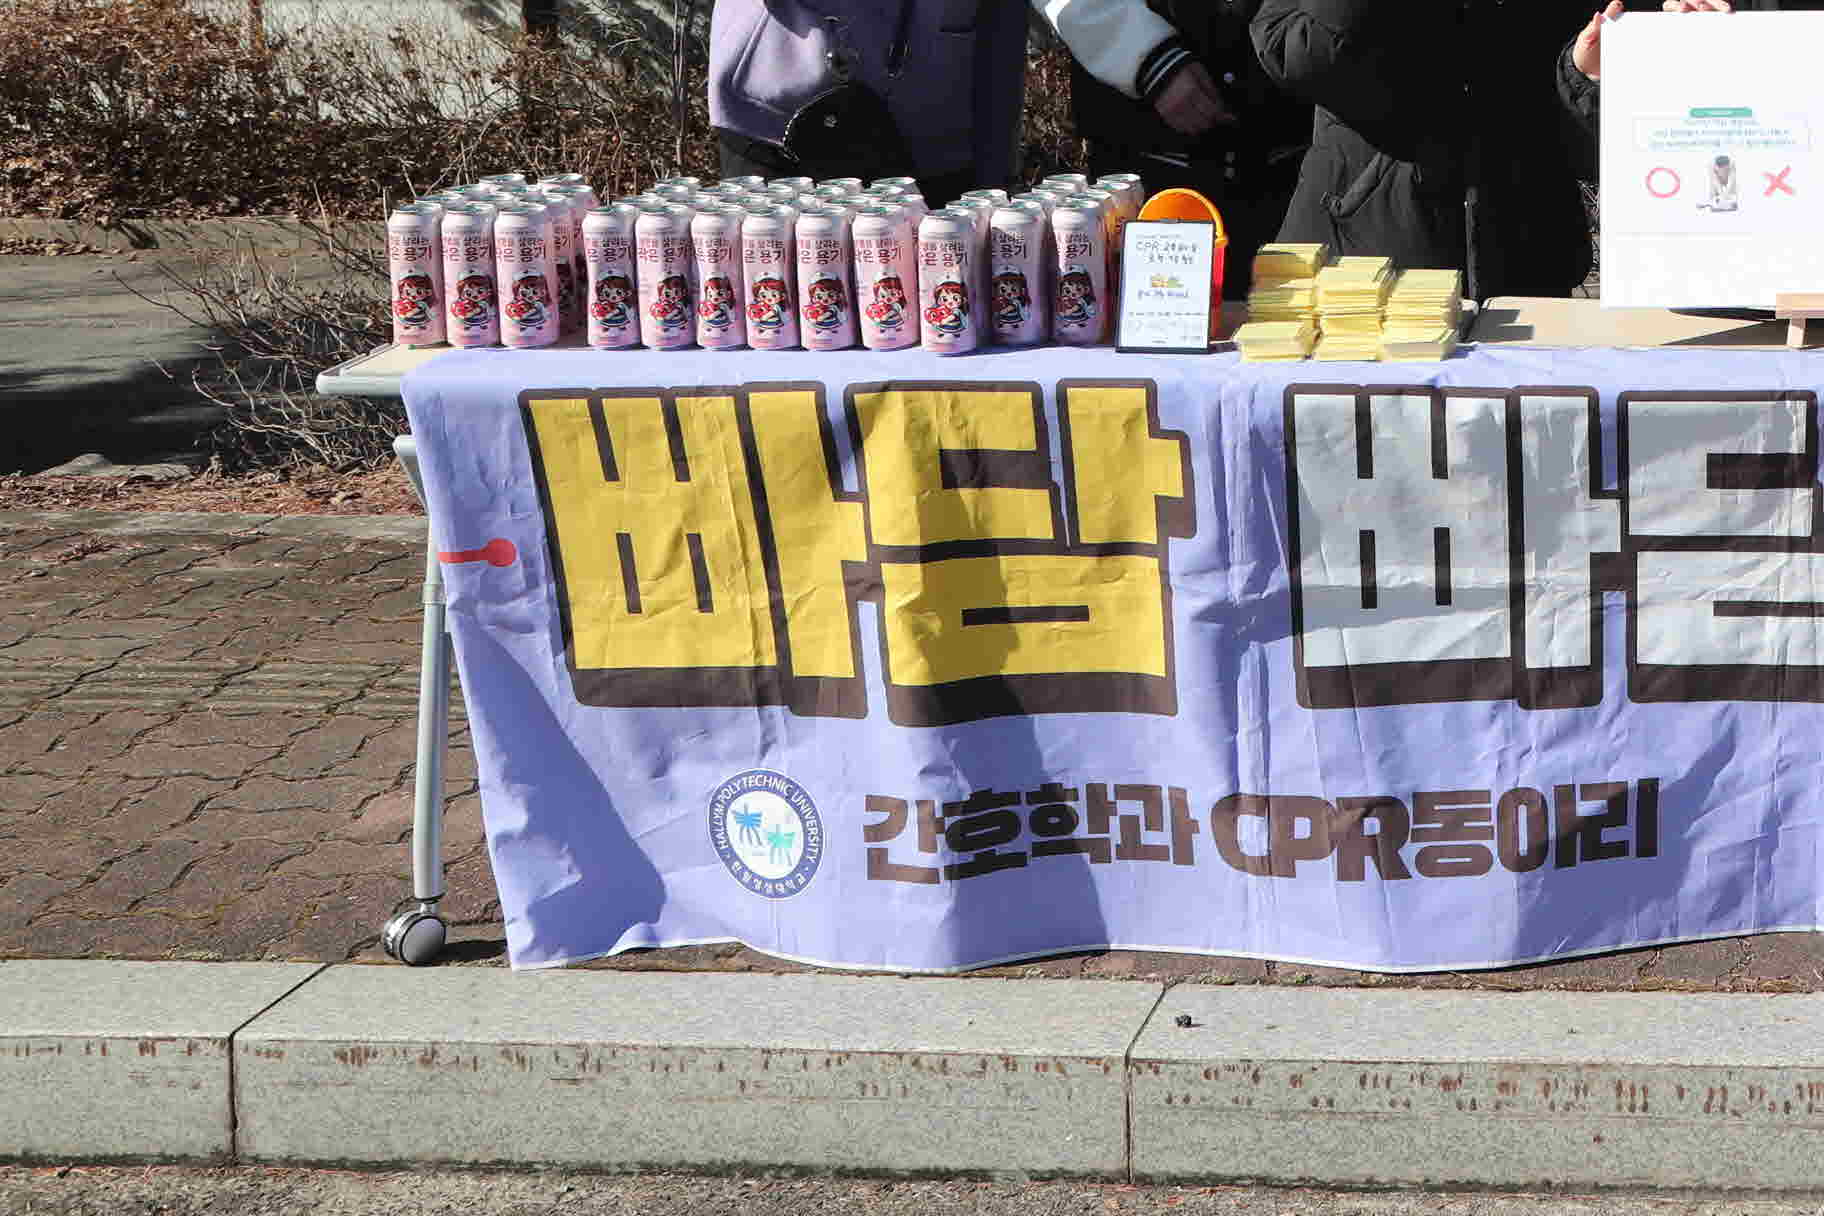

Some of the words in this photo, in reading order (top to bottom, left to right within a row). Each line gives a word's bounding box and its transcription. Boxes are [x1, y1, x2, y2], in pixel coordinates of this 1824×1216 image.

[520, 379, 1195, 727] 빠담
[790, 790, 819, 864] UNIVERSITY
[863, 779, 1200, 885] 간호학과
[1209, 777, 1660, 883] CPR동아리
